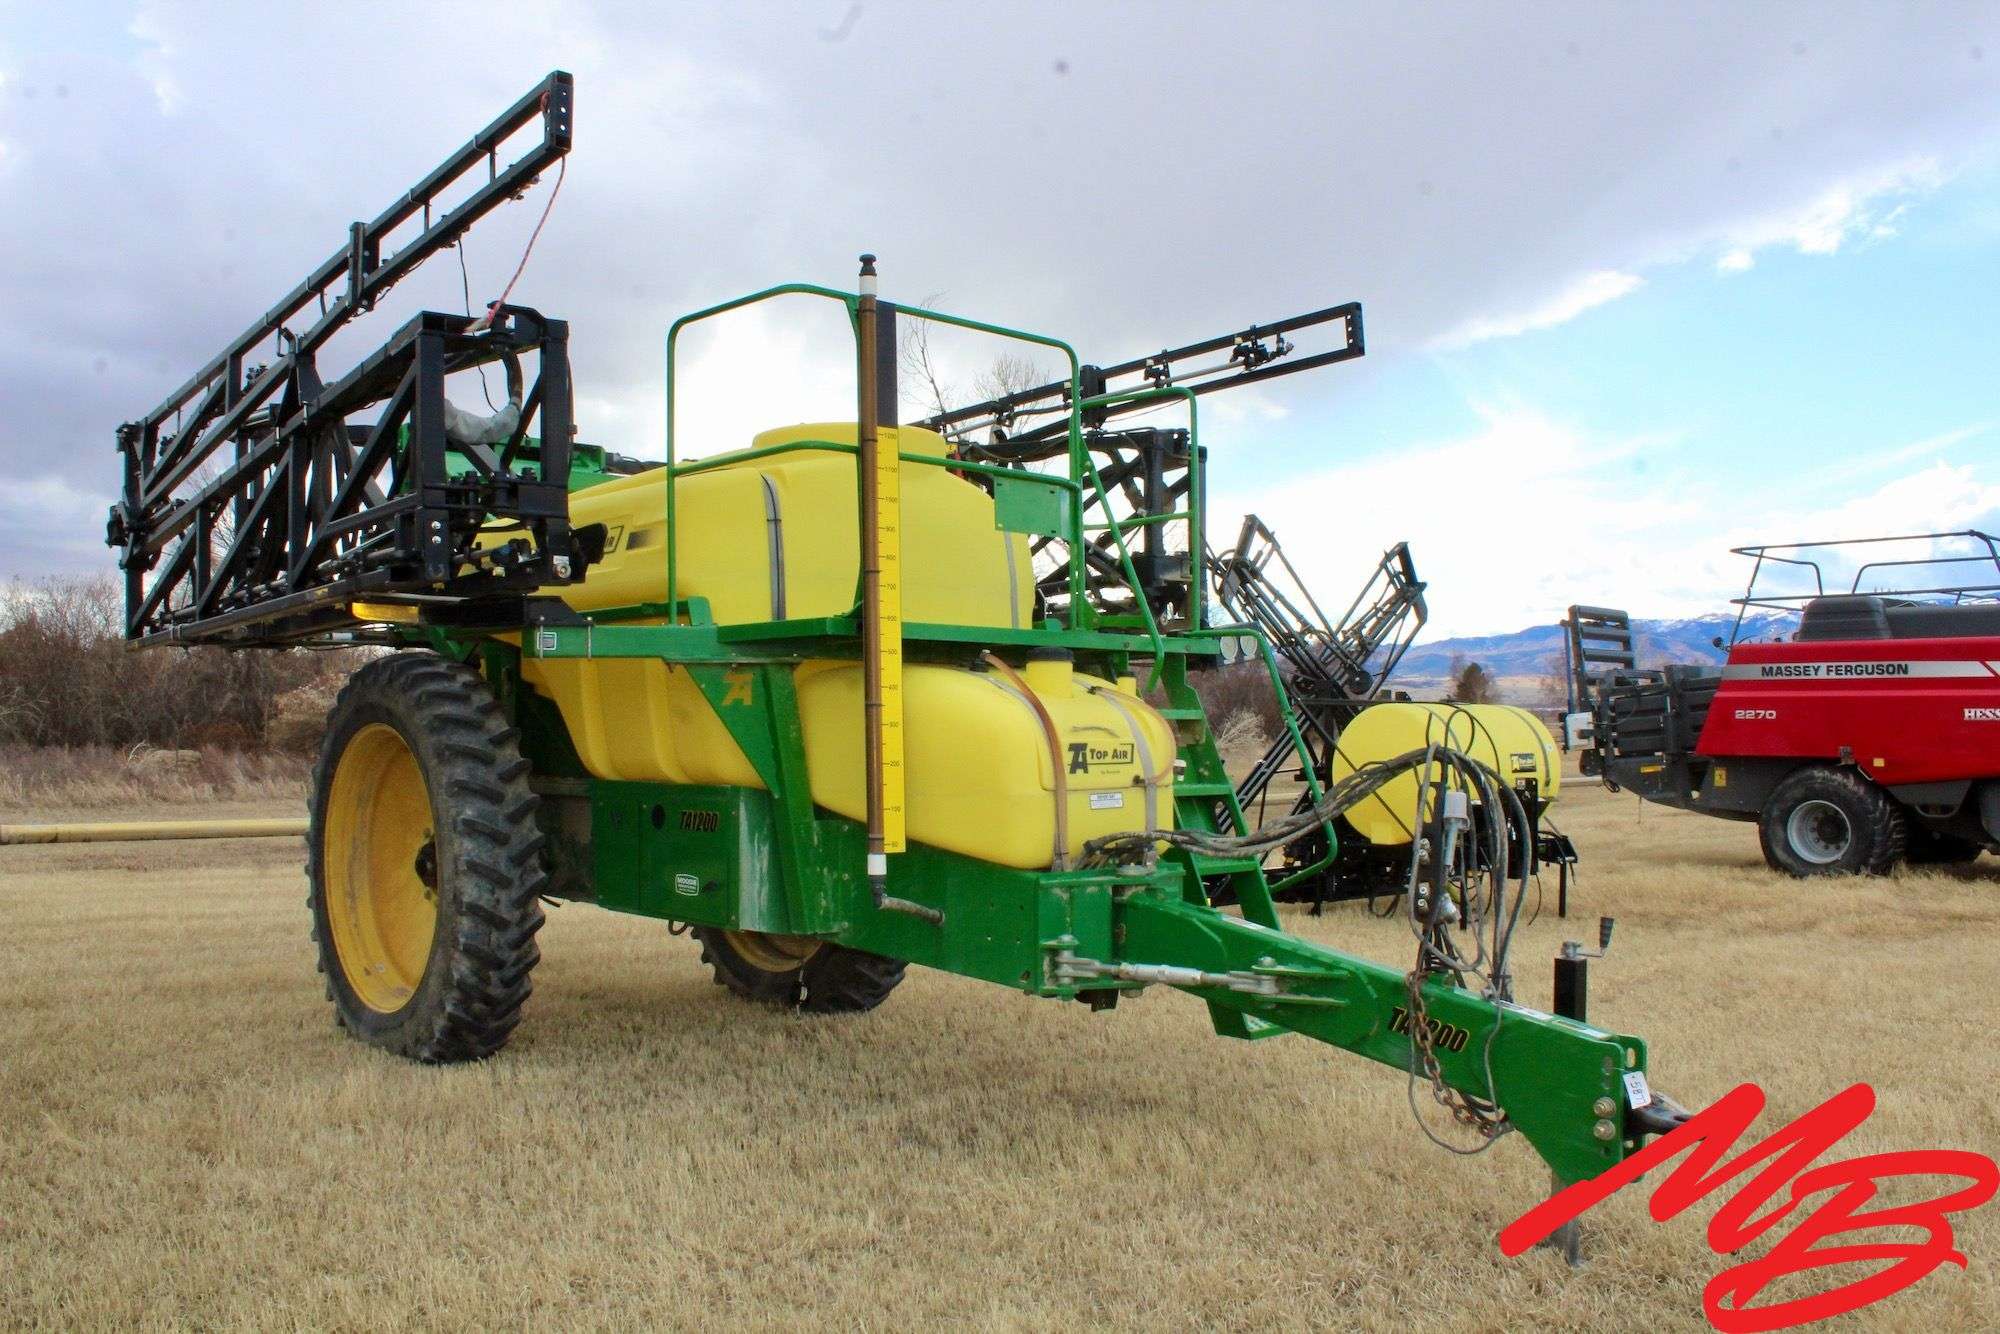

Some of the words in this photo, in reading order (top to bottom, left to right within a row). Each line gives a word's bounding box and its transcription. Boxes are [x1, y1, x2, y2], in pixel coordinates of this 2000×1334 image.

[1761, 664, 1821, 677] MASSEY
[1826, 663, 1909, 676] FERGUSON
[1734, 709, 1777, 720] 2270
[681, 809, 720, 832] TA1200
[1388, 1006, 1471, 1052] TA200
